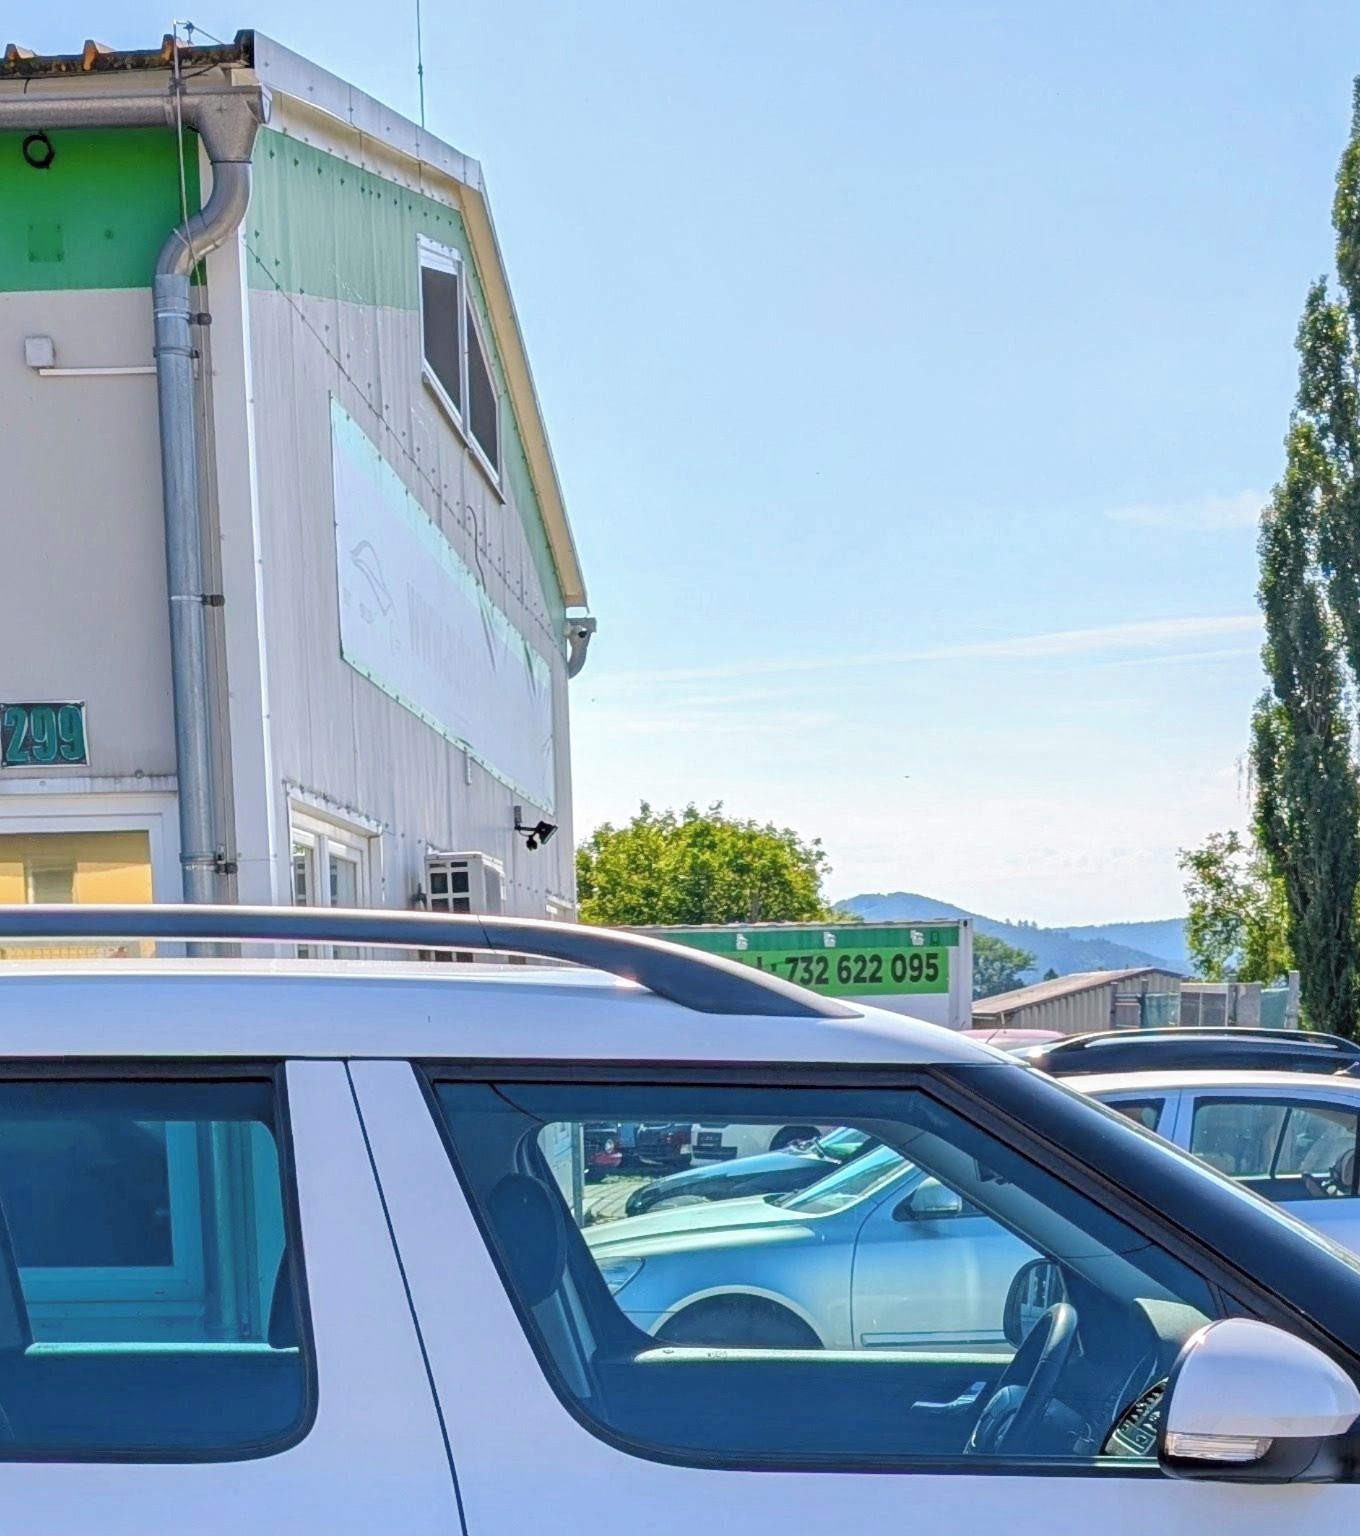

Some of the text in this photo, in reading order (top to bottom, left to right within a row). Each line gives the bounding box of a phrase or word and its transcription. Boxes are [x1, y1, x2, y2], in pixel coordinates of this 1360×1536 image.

[4, 705, 85, 762] 299
[785, 955, 829, 986] 732
[837, 954, 883, 985] 622
[890, 952, 939, 984] 095
